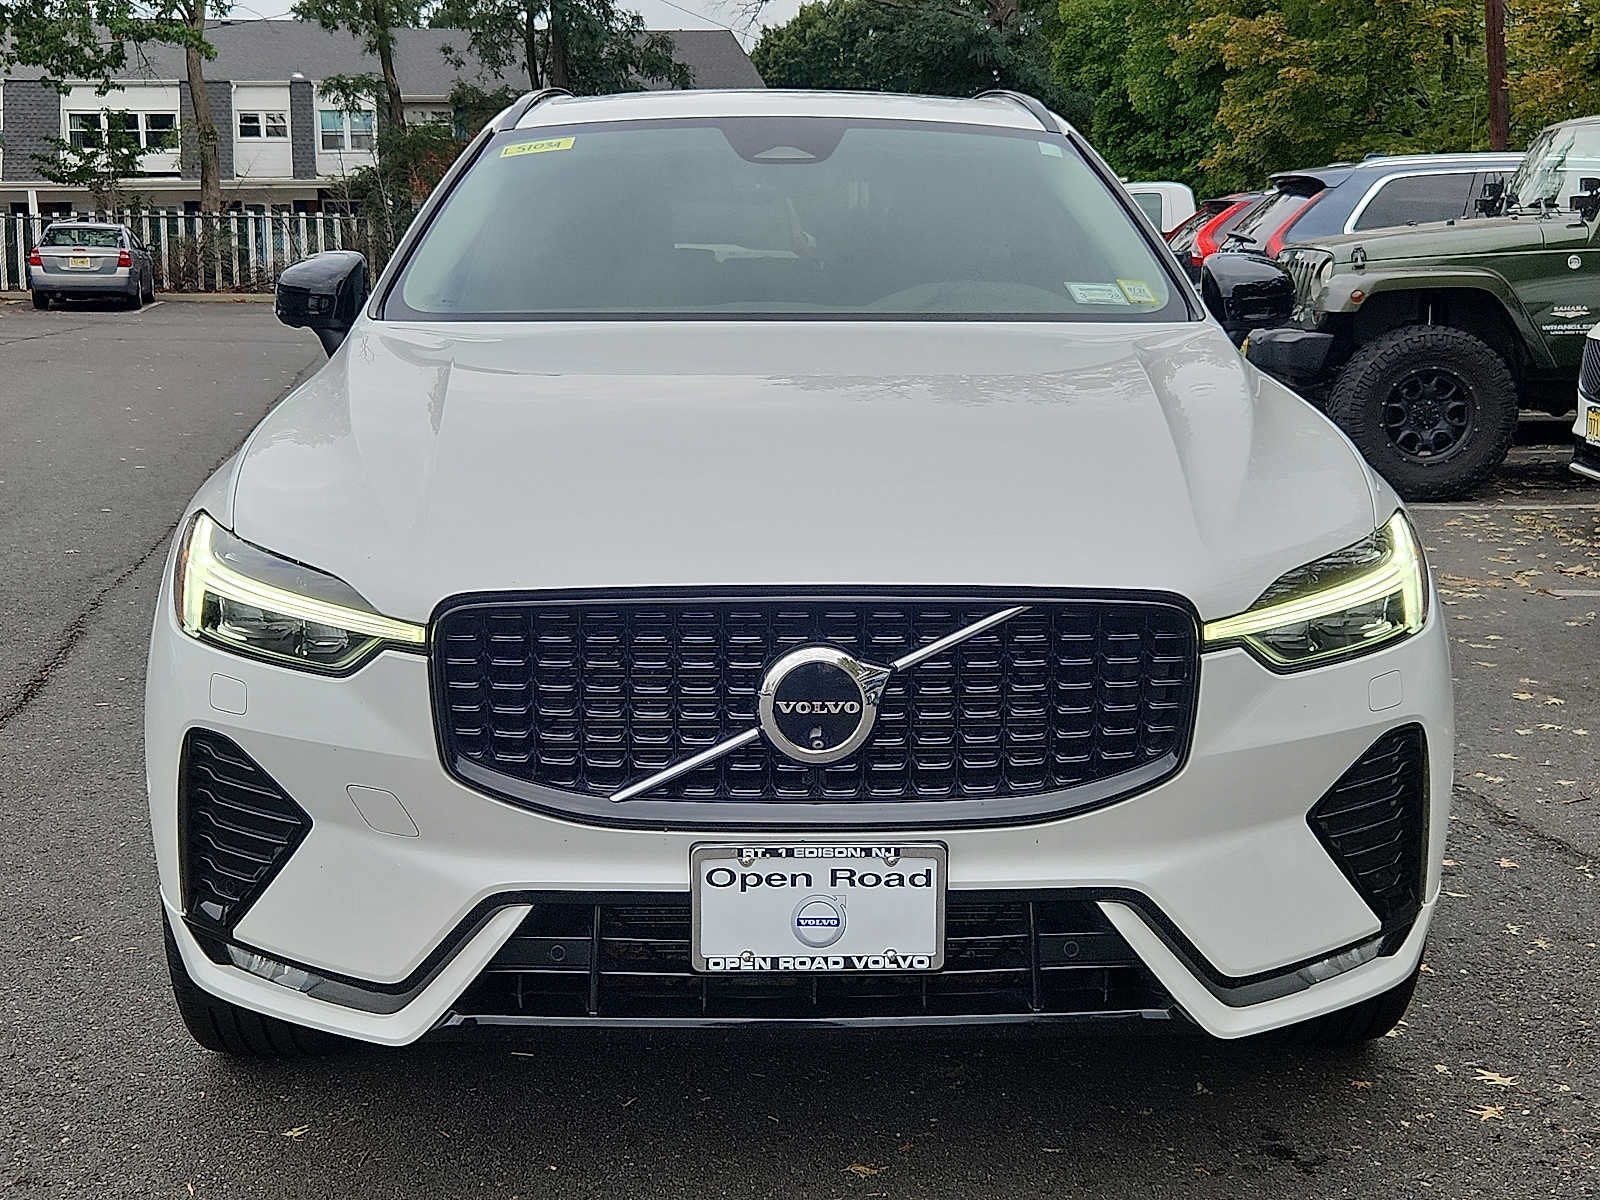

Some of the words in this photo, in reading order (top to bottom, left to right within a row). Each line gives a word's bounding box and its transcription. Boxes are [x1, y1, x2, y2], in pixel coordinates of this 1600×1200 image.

[775, 701, 860, 714] VOLVO
[777, 848, 786, 858] 1
[871, 847, 895, 858] NJ
[705, 867, 813, 893] Open
[829, 868, 932, 888] Road
[708, 957, 771, 970] OPEN
[778, 957, 845, 970] ROAD
[851, 956, 930, 969] VOLVO
